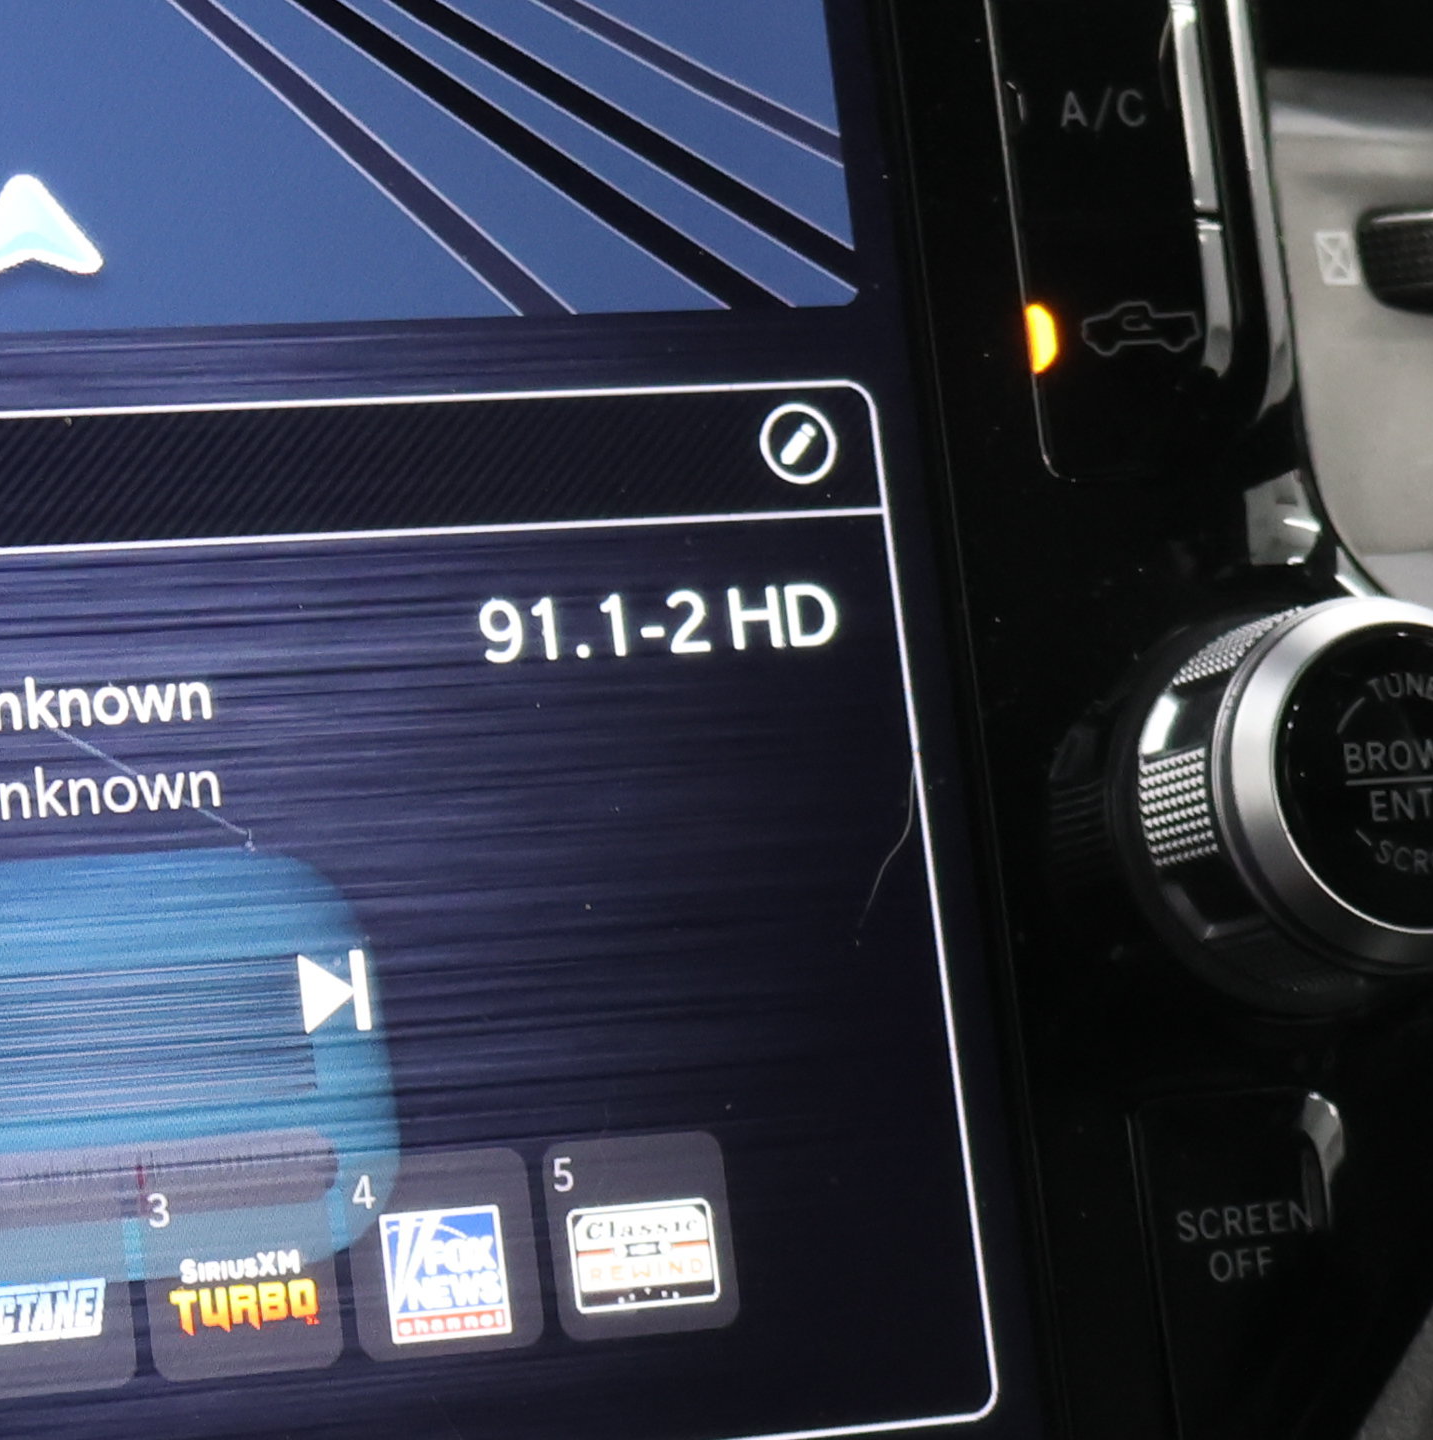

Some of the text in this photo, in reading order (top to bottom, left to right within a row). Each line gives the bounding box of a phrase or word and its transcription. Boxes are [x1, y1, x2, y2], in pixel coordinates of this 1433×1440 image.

[1062, 87, 1146, 131] A/C
[479, 583, 837, 663] 91.1-2 HD
[353, 1175, 374, 1208] 4
[554, 1158, 573, 1192] 5
[149, 1193, 169, 1228] 3
[1177, 1199, 1313, 1242] SCREEN
[424, 1235, 498, 1275] FOX
[590, 1258, 704, 1281] REWIND
[1209, 1246, 1271, 1282] OFF
[169, 1278, 320, 1336] TURBO
[407, 1271, 503, 1311] NEWS
